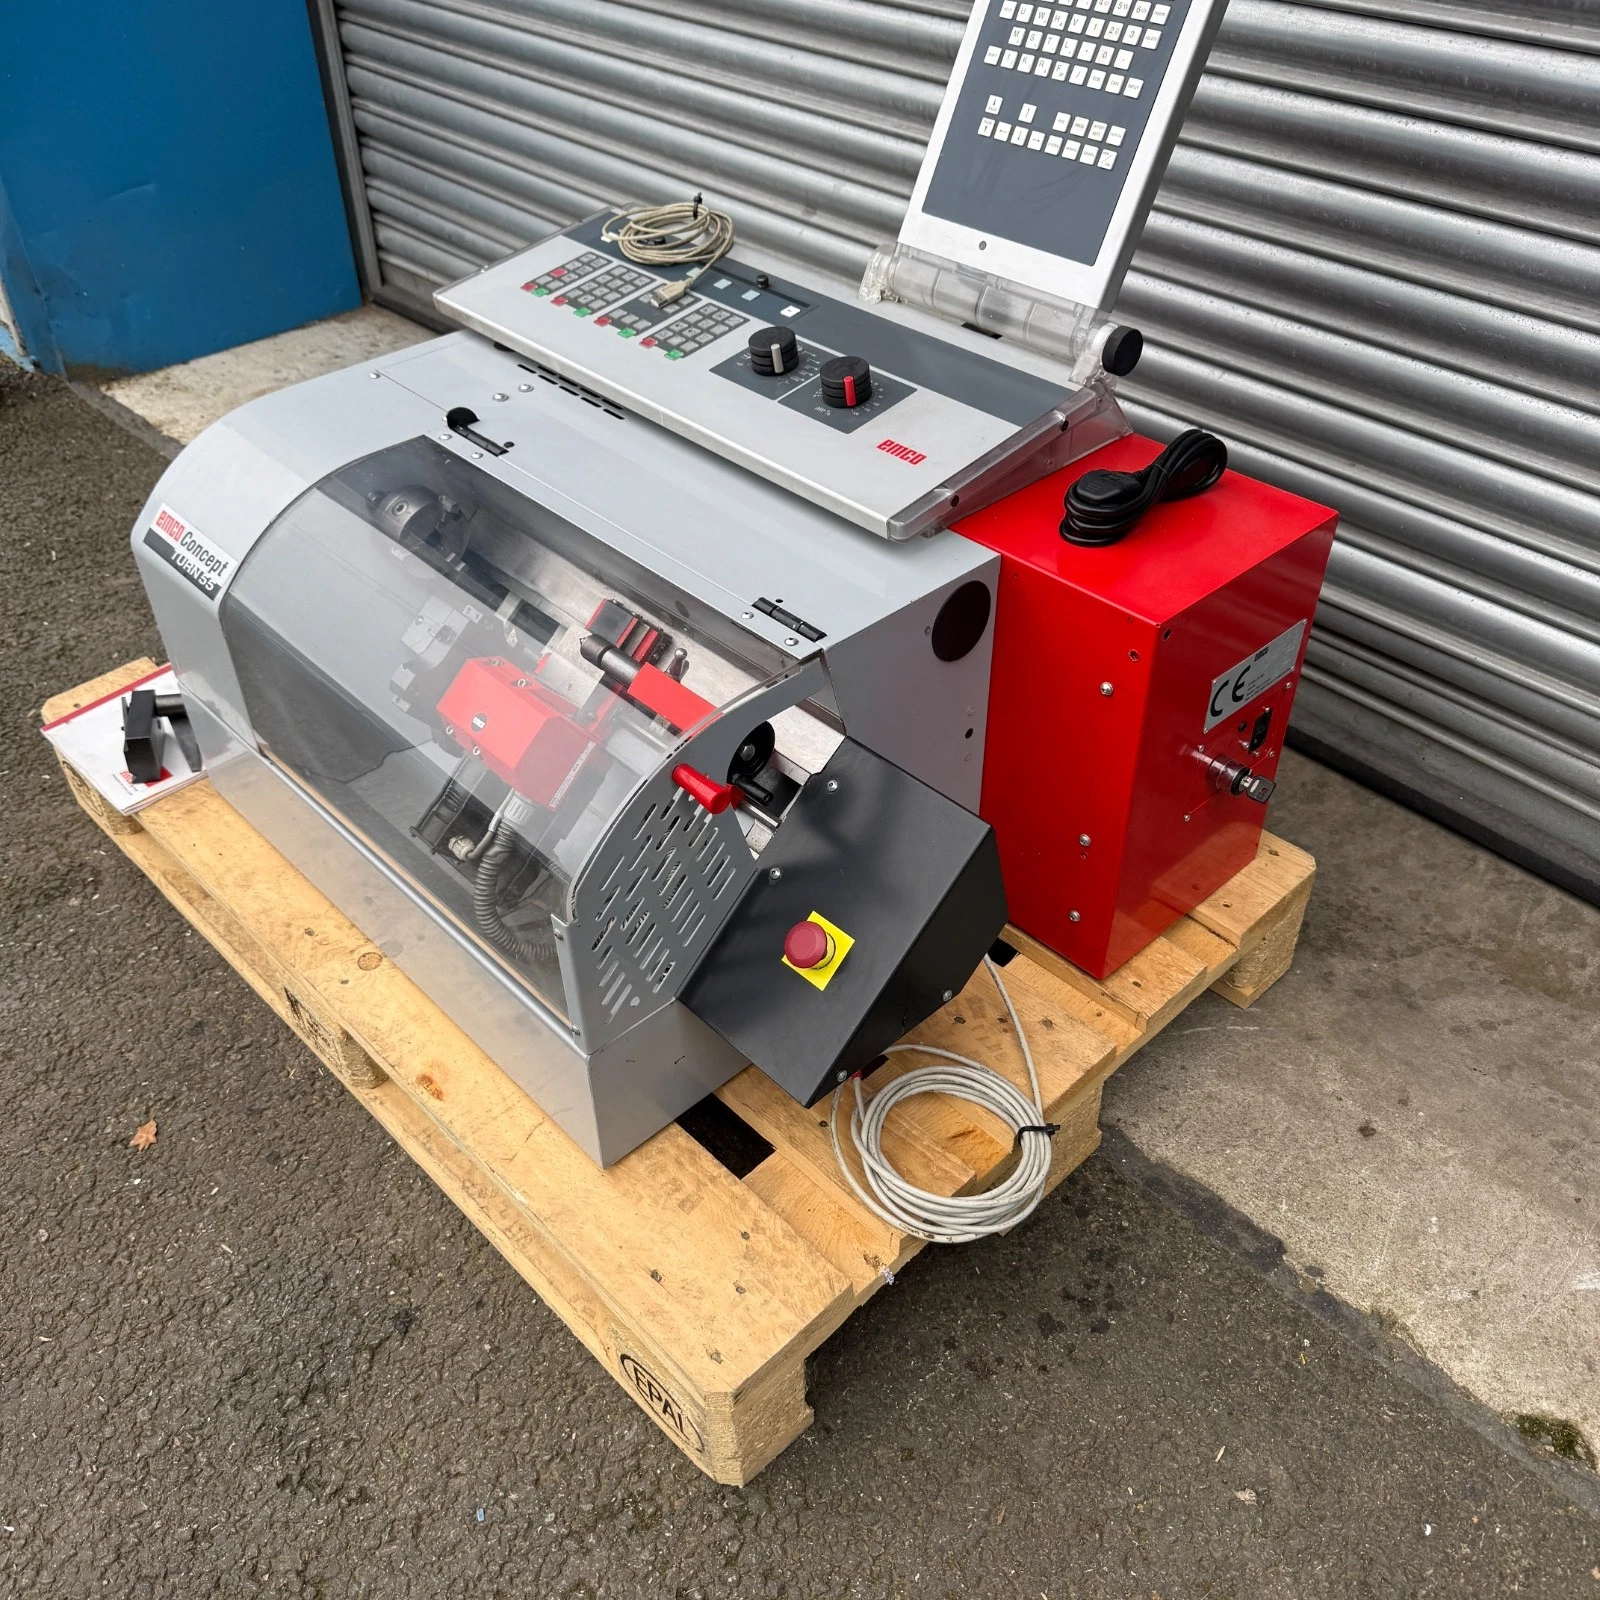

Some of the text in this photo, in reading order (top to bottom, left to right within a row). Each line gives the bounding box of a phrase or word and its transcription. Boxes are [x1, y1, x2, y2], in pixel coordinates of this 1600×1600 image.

[1038, 12, 1046, 20] W
[1054, 14, 1061, 22] H
[1073, 18, 1079, 26] V
[1029, 33, 1036, 41] S
[1129, 30, 1135, 38] 3
[1022, 56, 1028, 64] K
[1038, 60, 1045, 68] R
[1056, 64, 1062, 72] F
[876, 438, 928, 466] emco
[155, 510, 229, 577] emco Concept
[632, 1363, 691, 1441] EPAL
